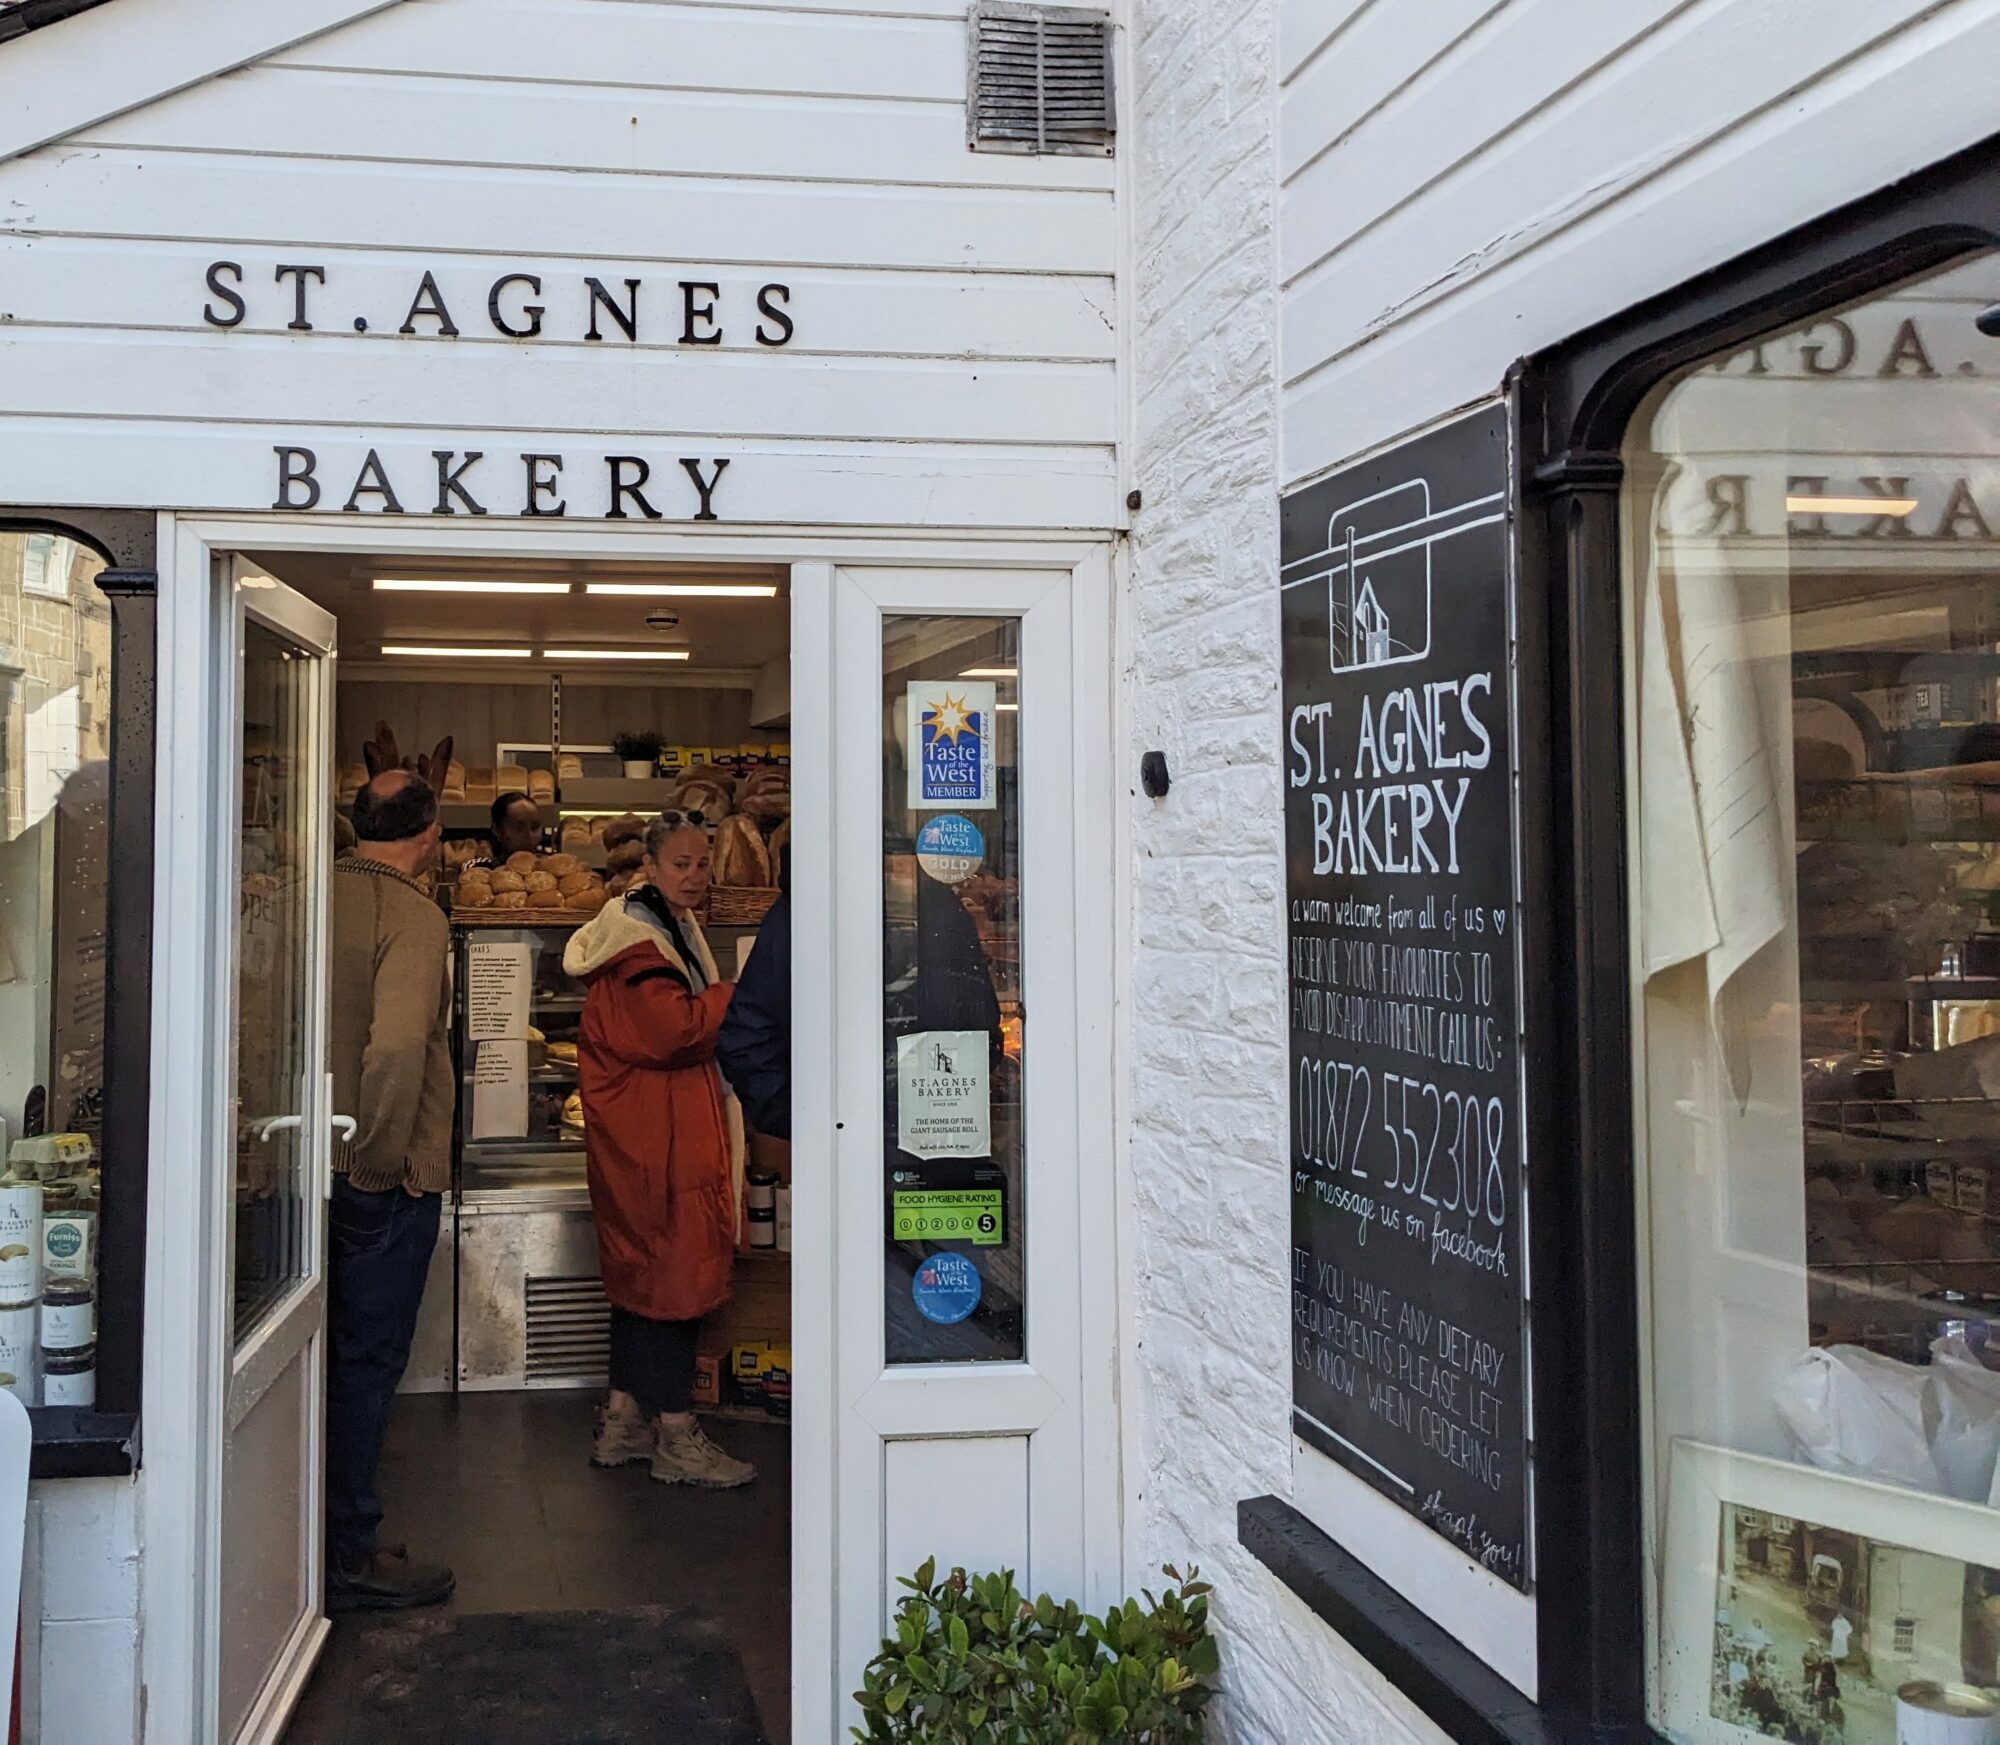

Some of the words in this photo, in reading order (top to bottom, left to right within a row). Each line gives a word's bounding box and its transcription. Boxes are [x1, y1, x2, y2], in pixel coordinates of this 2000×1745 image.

[272, 445, 730, 520] BAKERY
[925, 742, 976, 760] Taste
[1290, 702, 1340, 787] ST.
[1354, 672, 1491, 778] AGNES
[925, 764, 976, 782] West
[927, 787, 976, 797] MEMBER
[939, 819, 970, 832] Taste
[939, 834, 969, 846] West
[1312, 778, 1470, 875] BAKERY
[928, 858, 969, 870] GOLD
[1292, 900, 1300, 922] a
[1303, 900, 1330, 923] warm
[1335, 895, 1381, 928] welcome
[1387, 894, 1413, 936] from
[1419, 895, 1436, 929] all
[1444, 894, 1458, 942] of
[1464, 907, 1485, 933] us
[1292, 937, 1339, 984] RESERVE
[1344, 941, 1376, 990] YOUR
[1382, 944, 1463, 1002] FAVOURITES
[1470, 952, 1492, 1006] TO
[1293, 987, 1321, 1033] AVOID
[1439, 1011, 1471, 1067] CALL
[919, 1088, 970, 1096] BAKERY
[1300, 1056, 1371, 1178] 01872
[1384, 1072, 1505, 1226] 552308
[899, 1195, 925, 1203] FOOD
[927, 1195, 964, 1203] HYGIENE
[966, 1194, 996, 1202] RATING
[1295, 1171, 1310, 1192] or
[1314, 1178, 1375, 1246] message
[1381, 1205, 1400, 1230] us
[1406, 1214, 1426, 1242] on
[1431, 1211, 1509, 1277] facebook
[935, 1259, 968, 1271] Taste
[936, 1273, 968, 1285] West
[1294, 1247, 1310, 1283] IF
[1317, 1259, 1344, 1303] YOU
[1353, 1276, 1392, 1329] HAVE
[1398, 1302, 1432, 1345] ANY
[1294, 1331, 1311, 1370] US
[1317, 1344, 1355, 1397] KNOW
[1367, 1373, 1411, 1433] WHEN
[1420, 1406, 1501, 1491] ORDERING
[1399, 1344, 1461, 1416] PLEASE
[1470, 1385, 1503, 1438] LET
